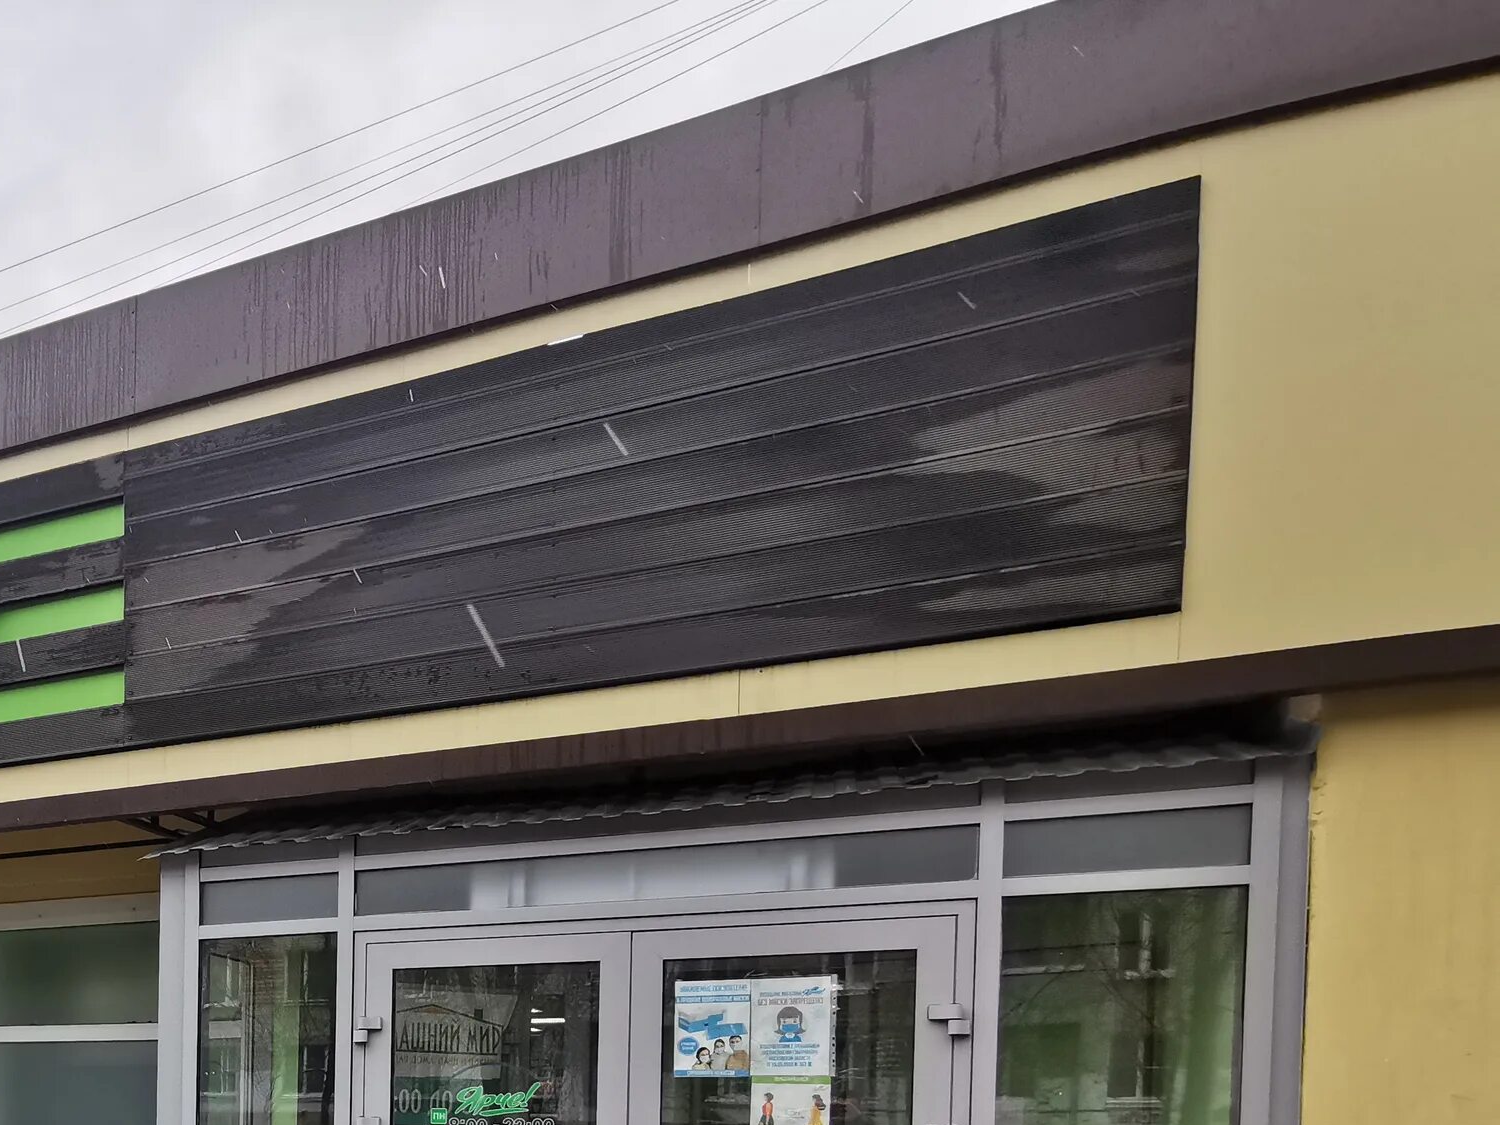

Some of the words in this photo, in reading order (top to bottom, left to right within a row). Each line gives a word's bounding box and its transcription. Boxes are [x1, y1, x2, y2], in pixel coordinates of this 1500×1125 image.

[396, 1018, 461, 1052] АШНИЙ
[466, 1023, 501, 1053] МИР
[432, 1111, 446, 1121] ПН
[454, 1082, 541, 1116] Ярче!
